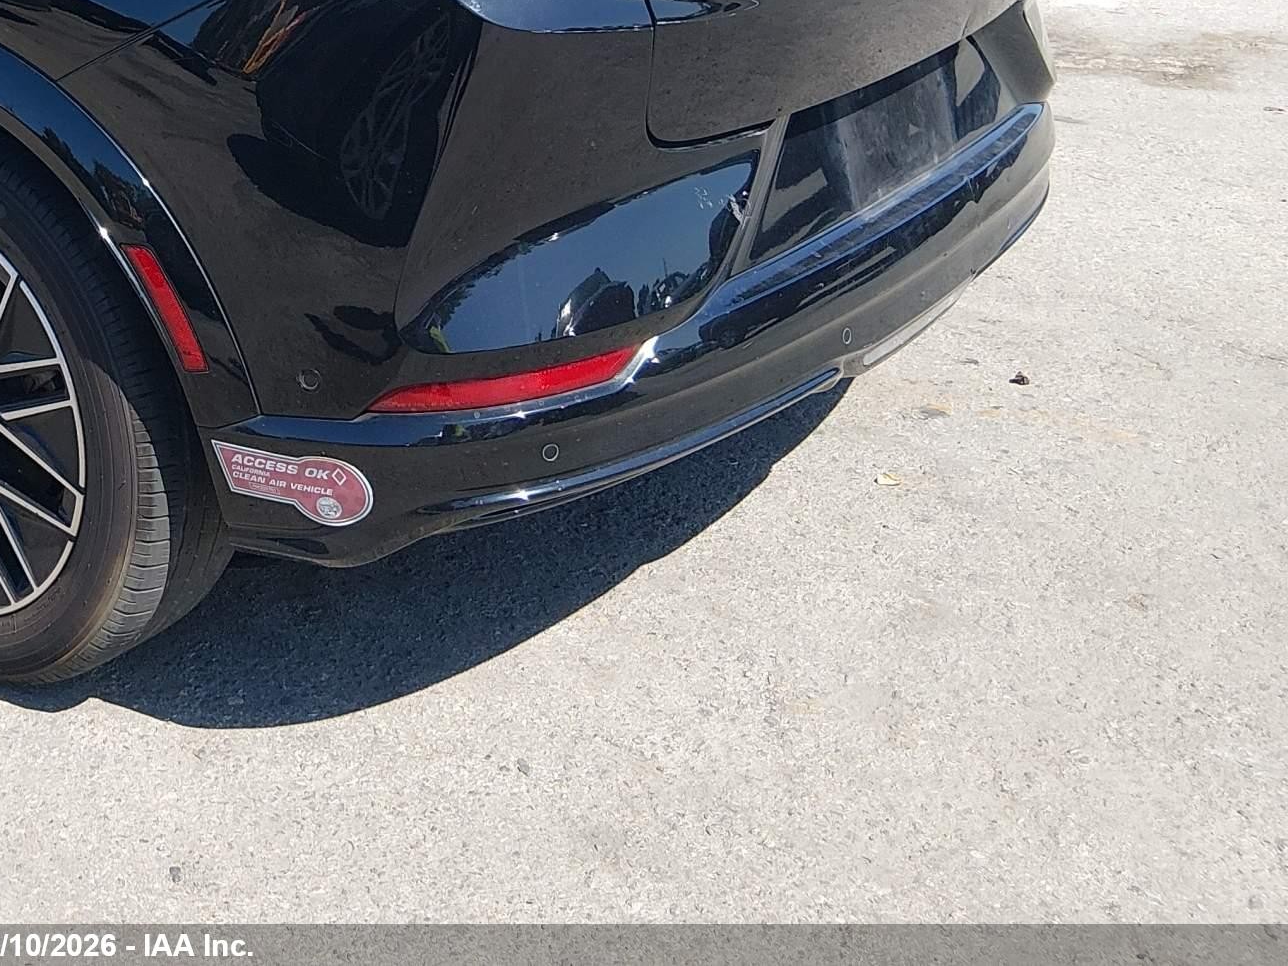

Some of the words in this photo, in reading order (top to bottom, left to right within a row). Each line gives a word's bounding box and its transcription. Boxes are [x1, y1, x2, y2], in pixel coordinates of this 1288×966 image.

[231, 463, 271, 478] CALIFORNIA
[232, 453, 299, 474] ACCESS
[304, 467, 330, 480] OK
[232, 470, 266, 485] CLEAN
[268, 478, 287, 488] AIR
[290, 483, 334, 496] VEHICLE
